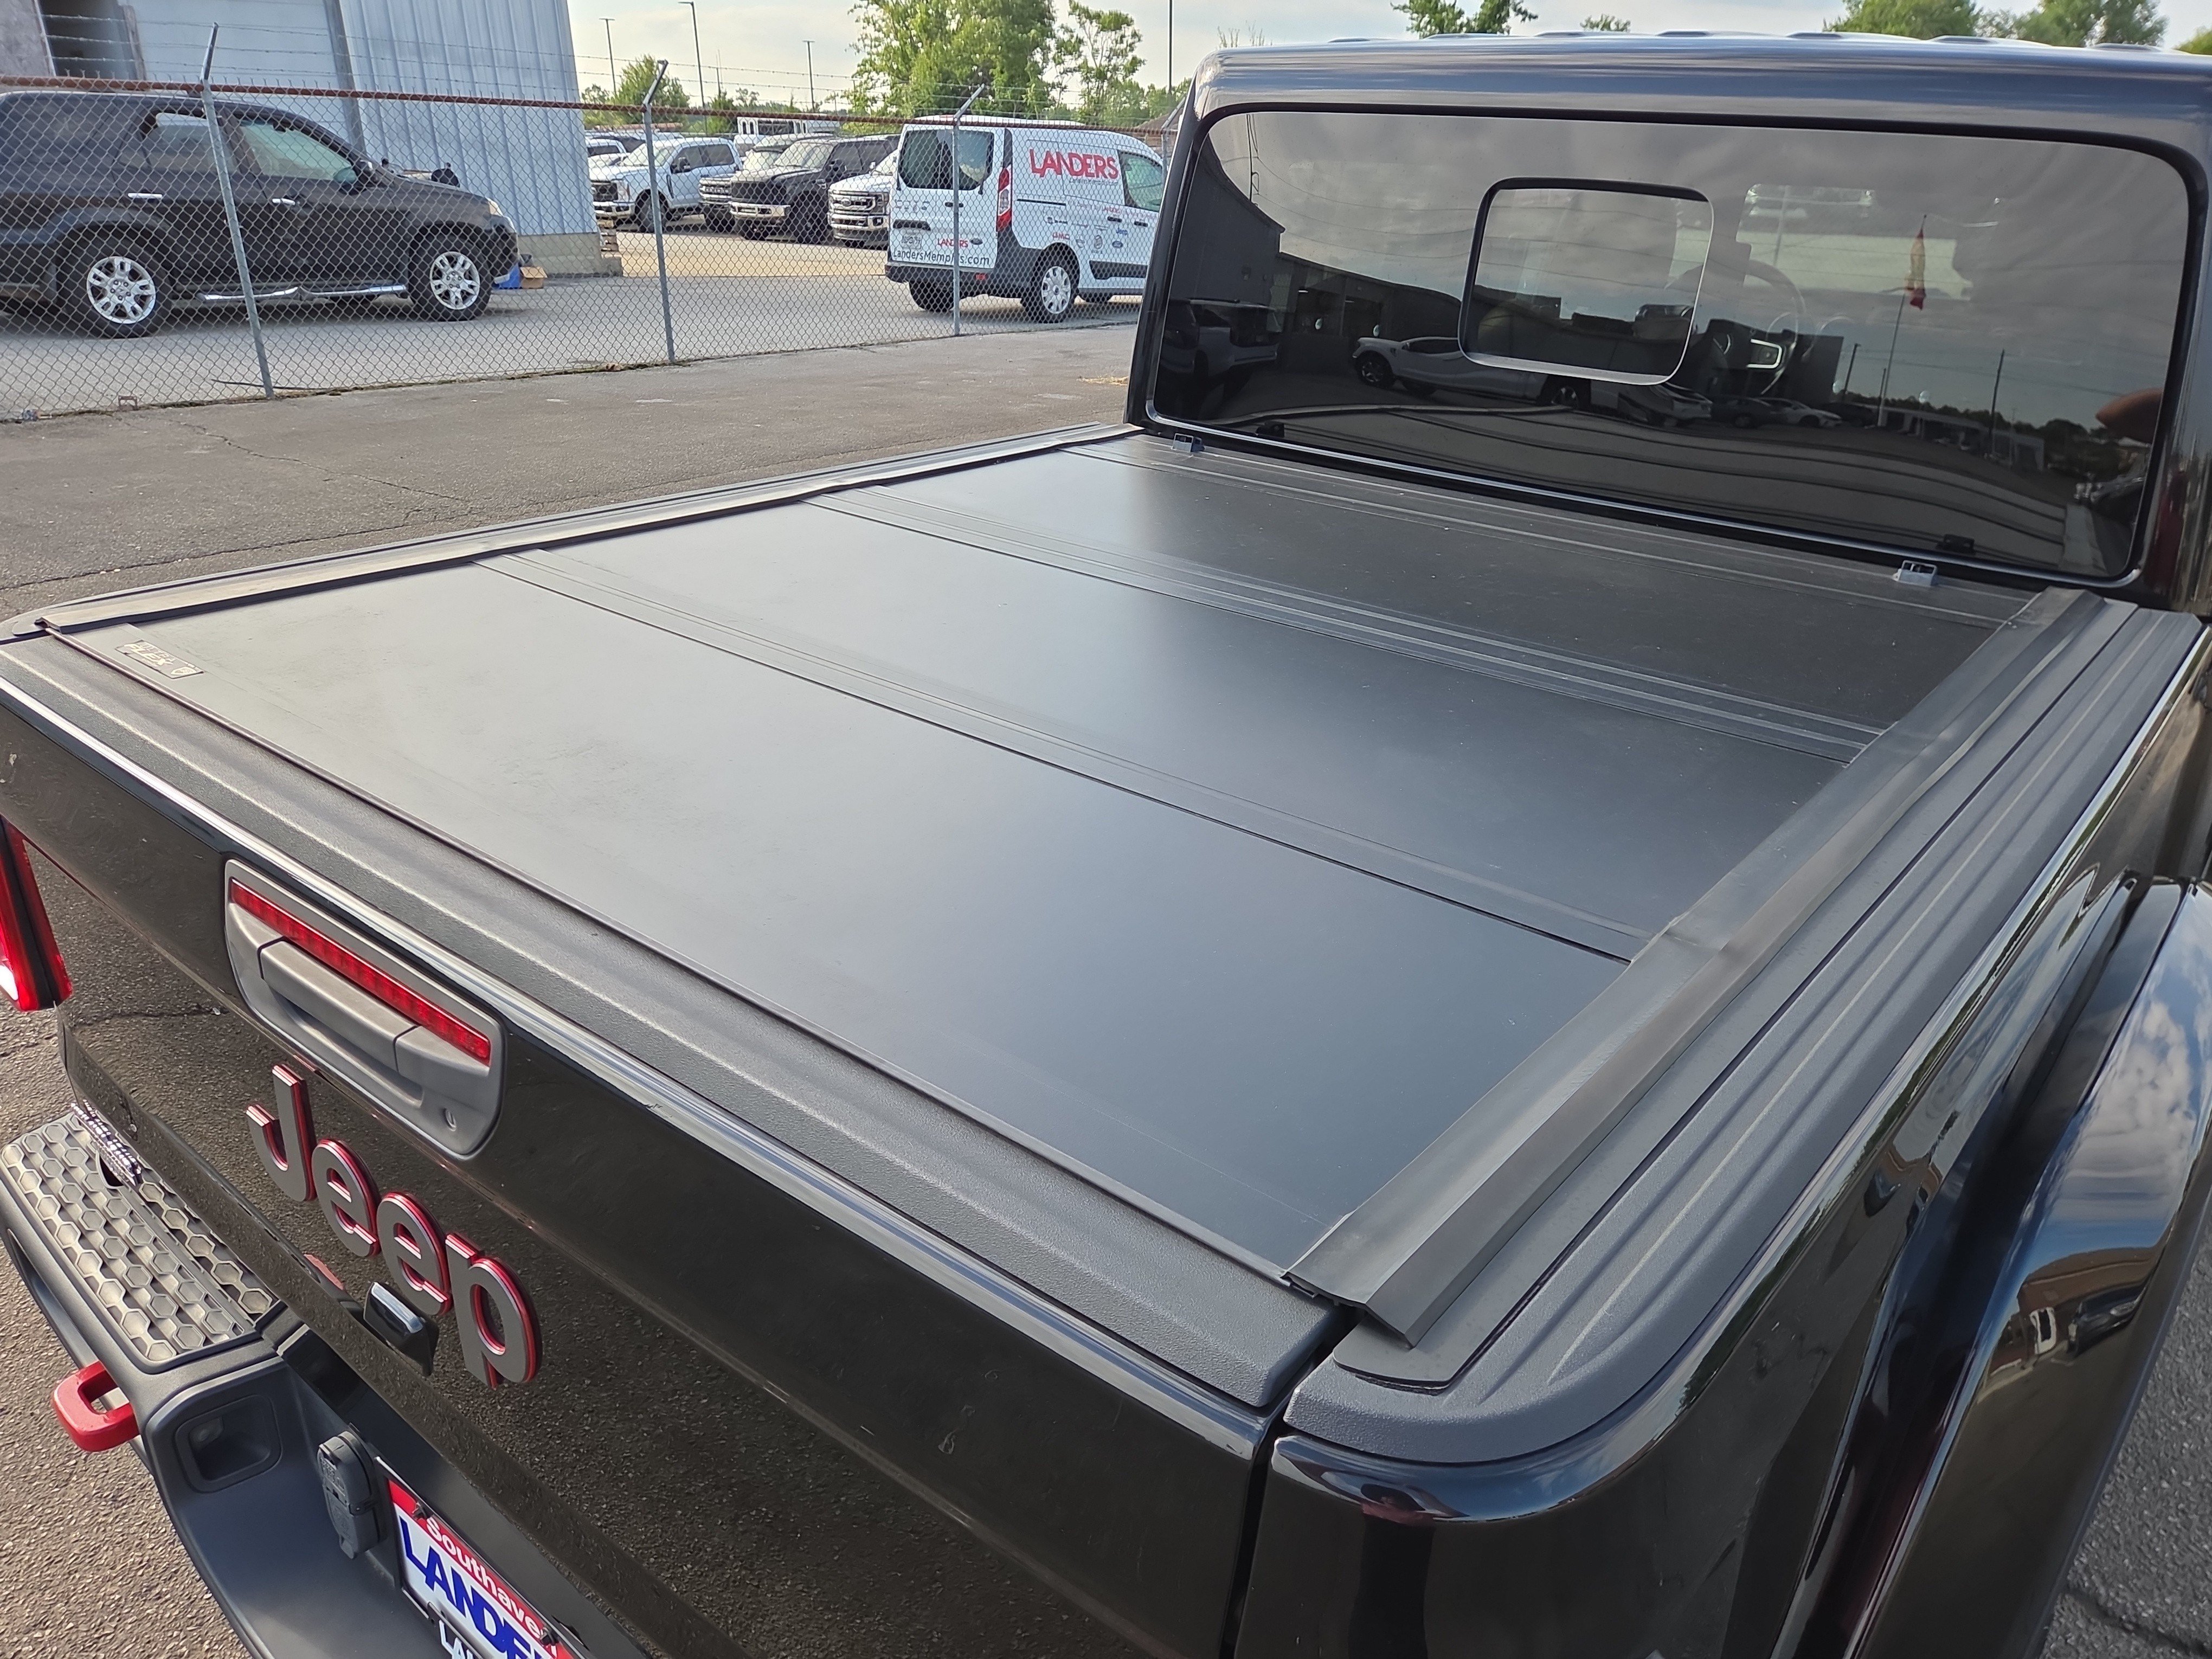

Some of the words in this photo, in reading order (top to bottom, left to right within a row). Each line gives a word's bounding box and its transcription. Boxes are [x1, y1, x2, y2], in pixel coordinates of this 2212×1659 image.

[1030, 149, 1118, 178] LANDERS
[937, 238, 969, 248] LANDRS
[894, 250, 989, 265] LandersMemps.com
[246, 1064, 541, 1389] Jeep
